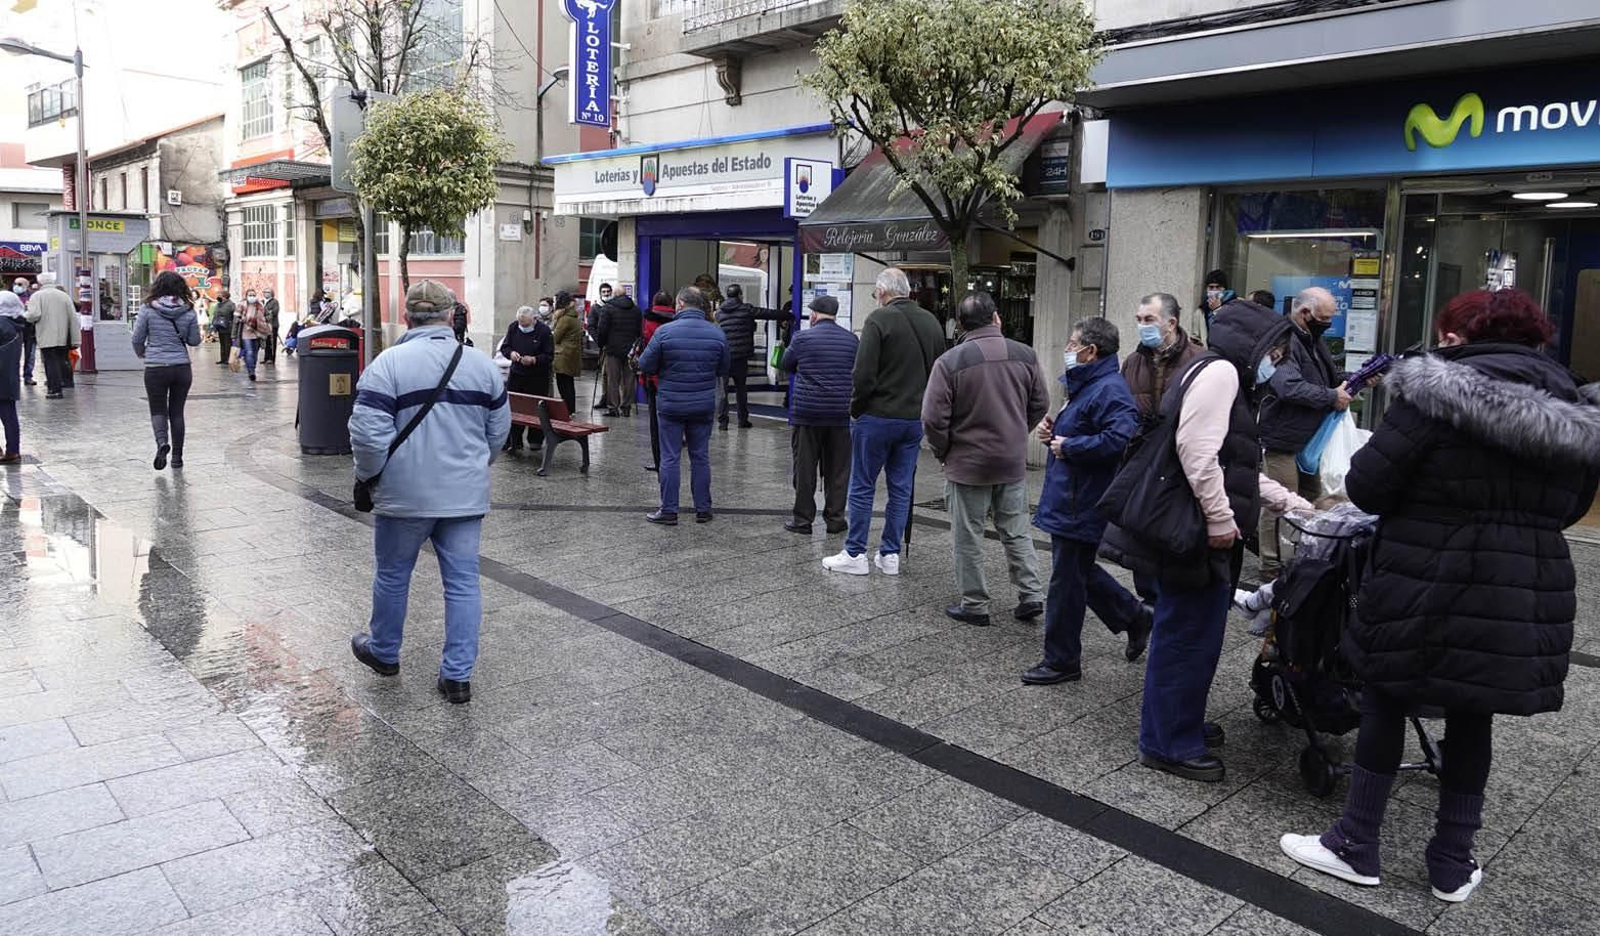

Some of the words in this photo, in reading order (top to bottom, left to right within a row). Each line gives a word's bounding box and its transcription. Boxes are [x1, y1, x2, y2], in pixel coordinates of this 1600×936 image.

[594, 114, 604, 122] 10
[1496, 99, 1600, 133] mov
[662, 162, 709, 180] Apuestas
[711, 156, 729, 173] del
[731, 152, 772, 172] Estado
[1046, 166, 1067, 177] 24H
[632, 169, 639, 184] y
[86, 220, 120, 231] ONCE
[883, 221, 937, 249] González
[20, 244, 42, 252] BBVA
